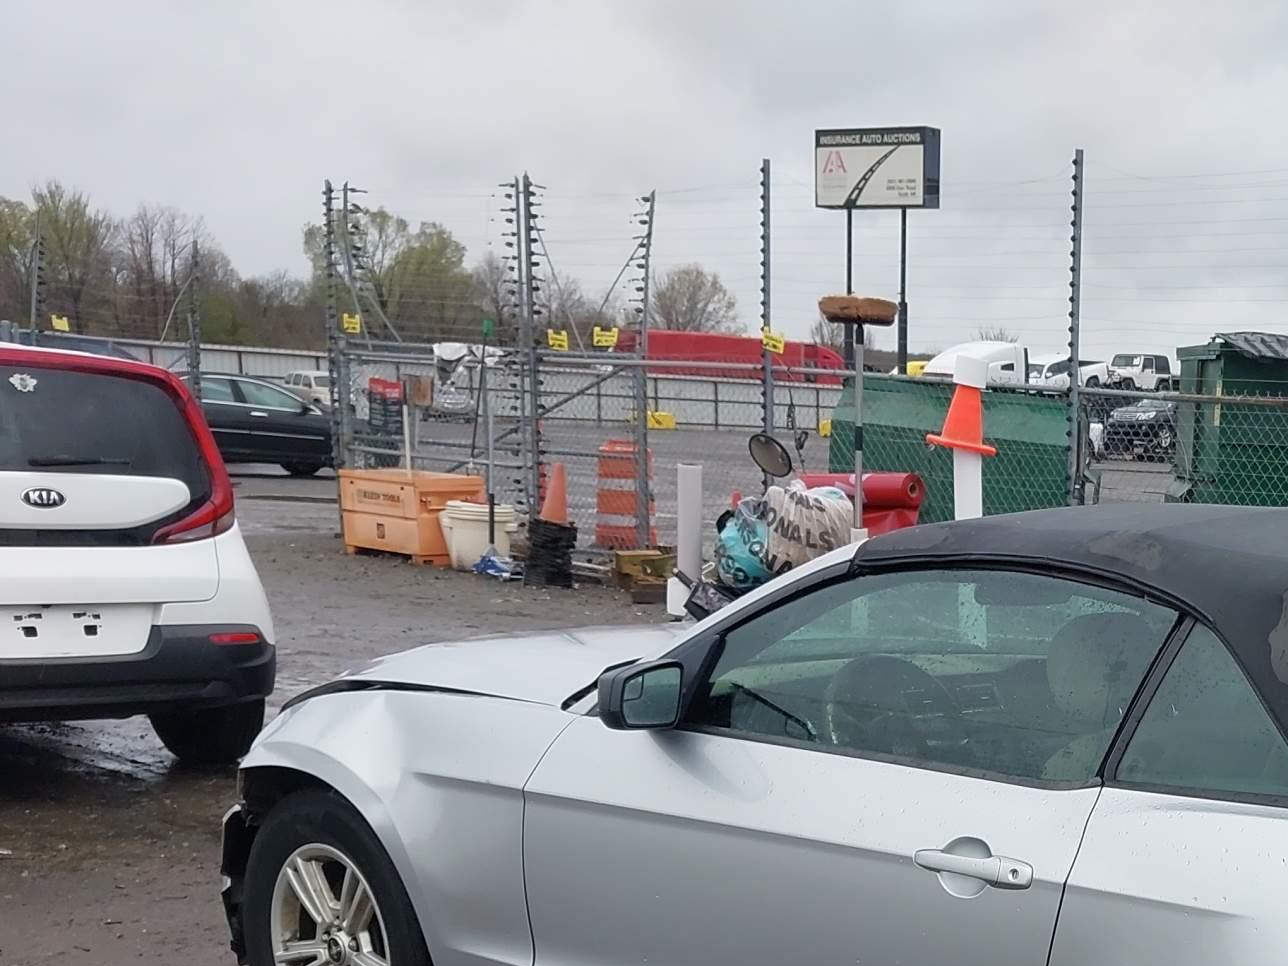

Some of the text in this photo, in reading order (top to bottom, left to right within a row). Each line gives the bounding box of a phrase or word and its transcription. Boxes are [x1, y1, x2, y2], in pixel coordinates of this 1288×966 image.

[819, 132, 921, 145] INSURANCE AUTO AUCTIONS
[28, 490, 61, 505] KIA
